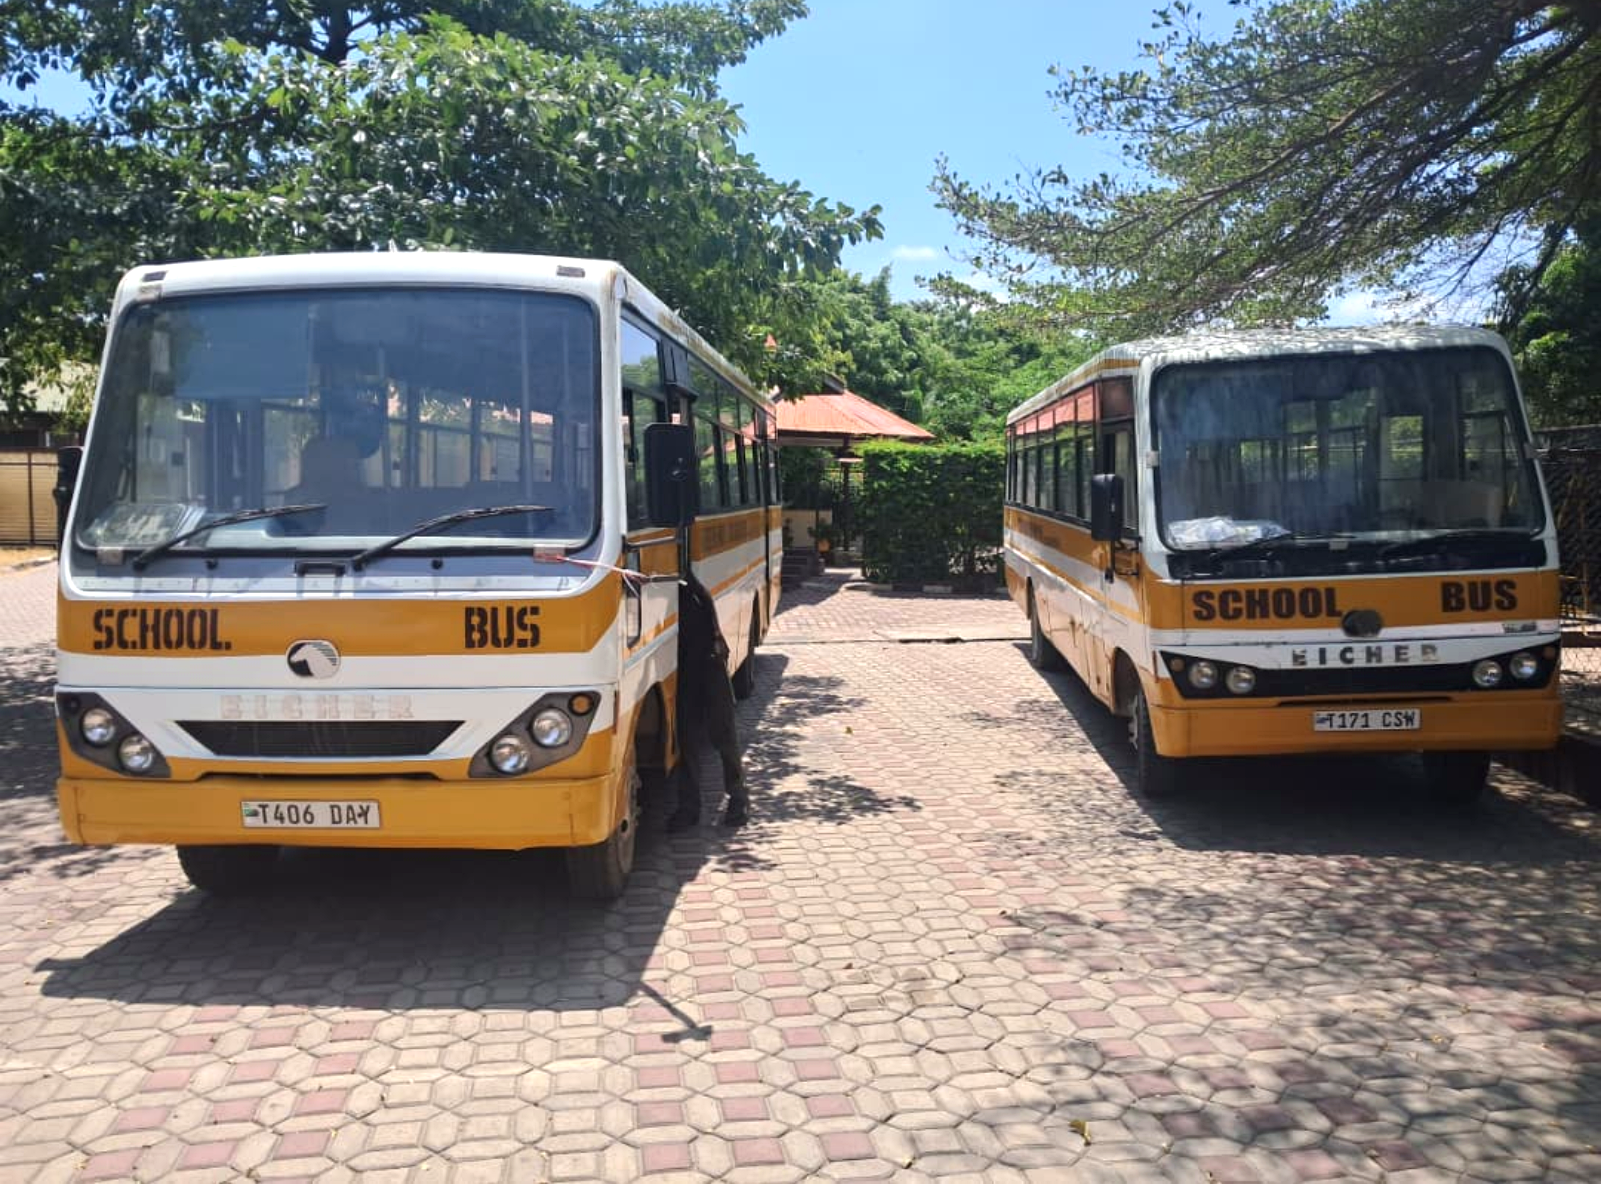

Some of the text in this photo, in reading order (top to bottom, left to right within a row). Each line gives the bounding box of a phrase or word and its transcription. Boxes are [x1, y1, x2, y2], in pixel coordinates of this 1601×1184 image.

[1193, 580, 1518, 621] SCHOOL BUS
[465, 606, 540, 648] BUS
[1292, 644, 1438, 666] EICHER
[220, 694, 414, 719] EICHER
[1327, 711, 1415, 729] T171 CSW
[258, 804, 370, 824] T406 DAY
